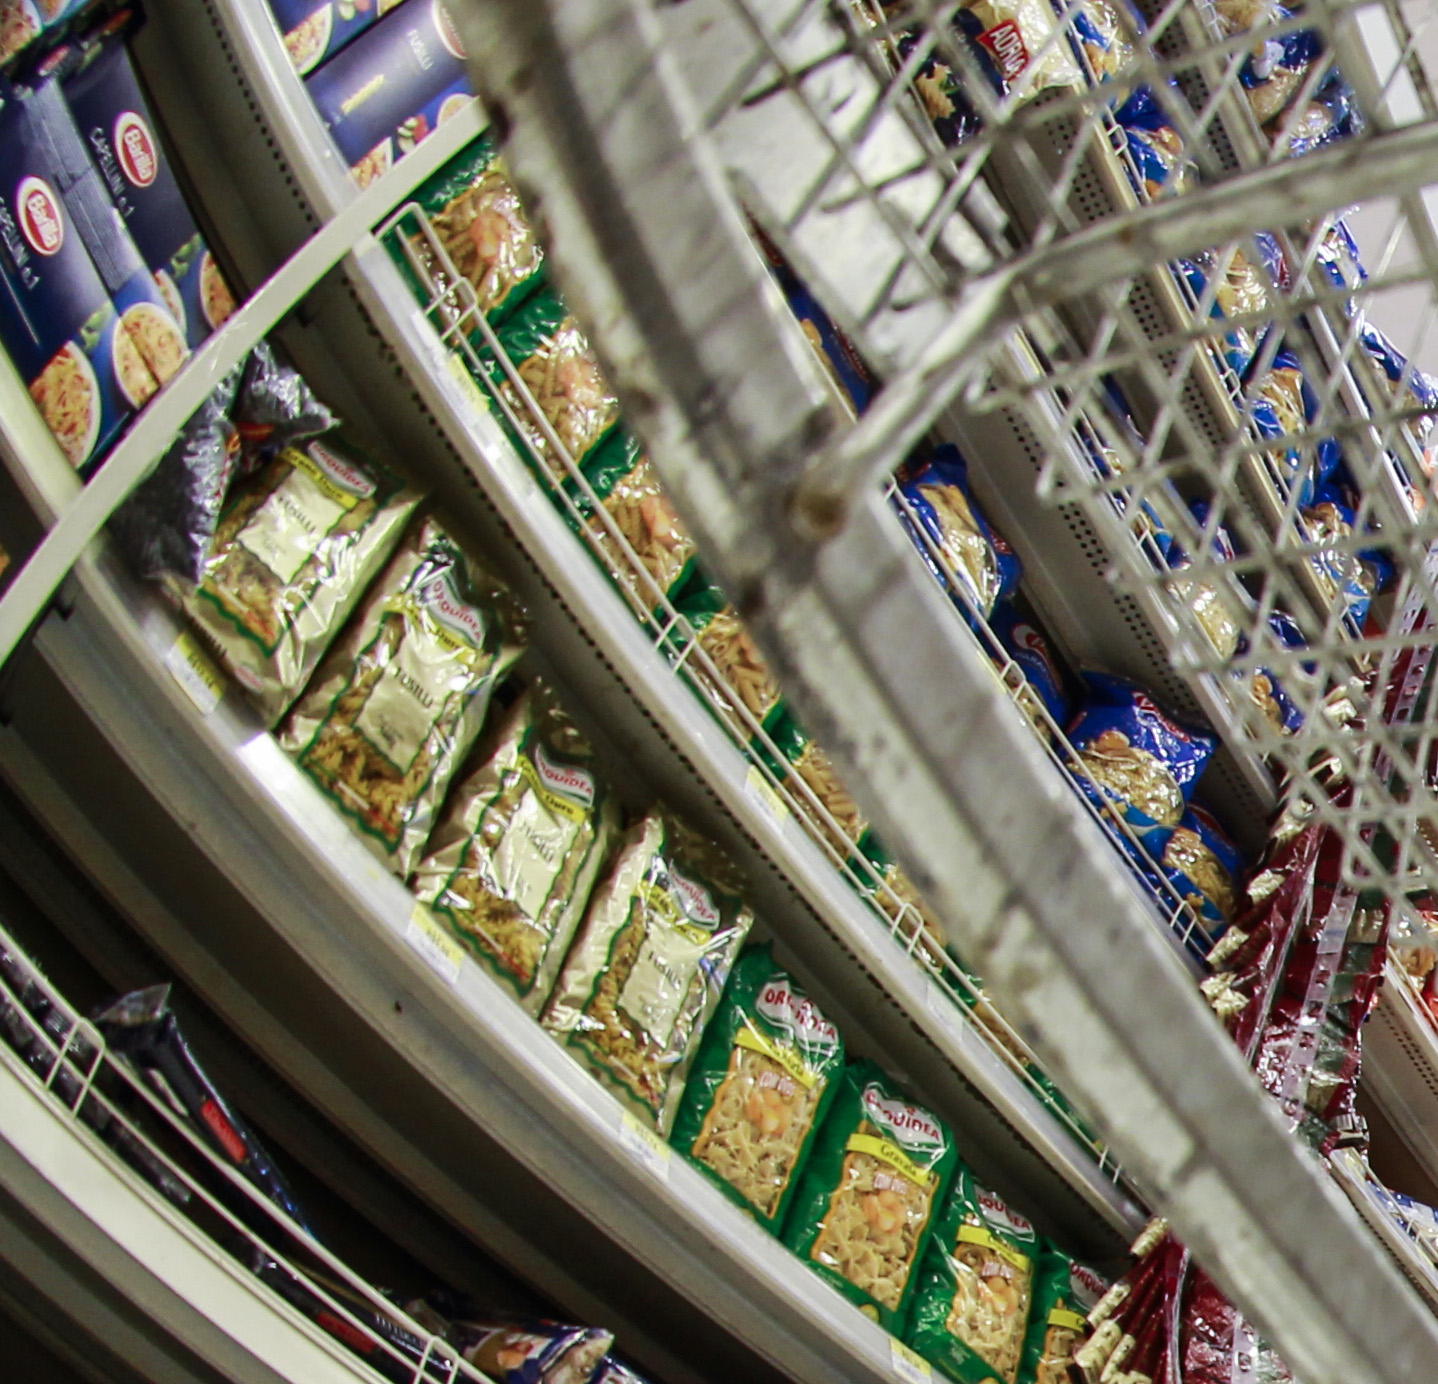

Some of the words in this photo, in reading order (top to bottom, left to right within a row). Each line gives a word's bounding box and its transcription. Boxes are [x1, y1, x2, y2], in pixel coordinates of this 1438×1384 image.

[123, 128, 153, 181] Barilla
[0, 199, 31, 268] APELLINI
[26, 193, 61, 248] Barilla
